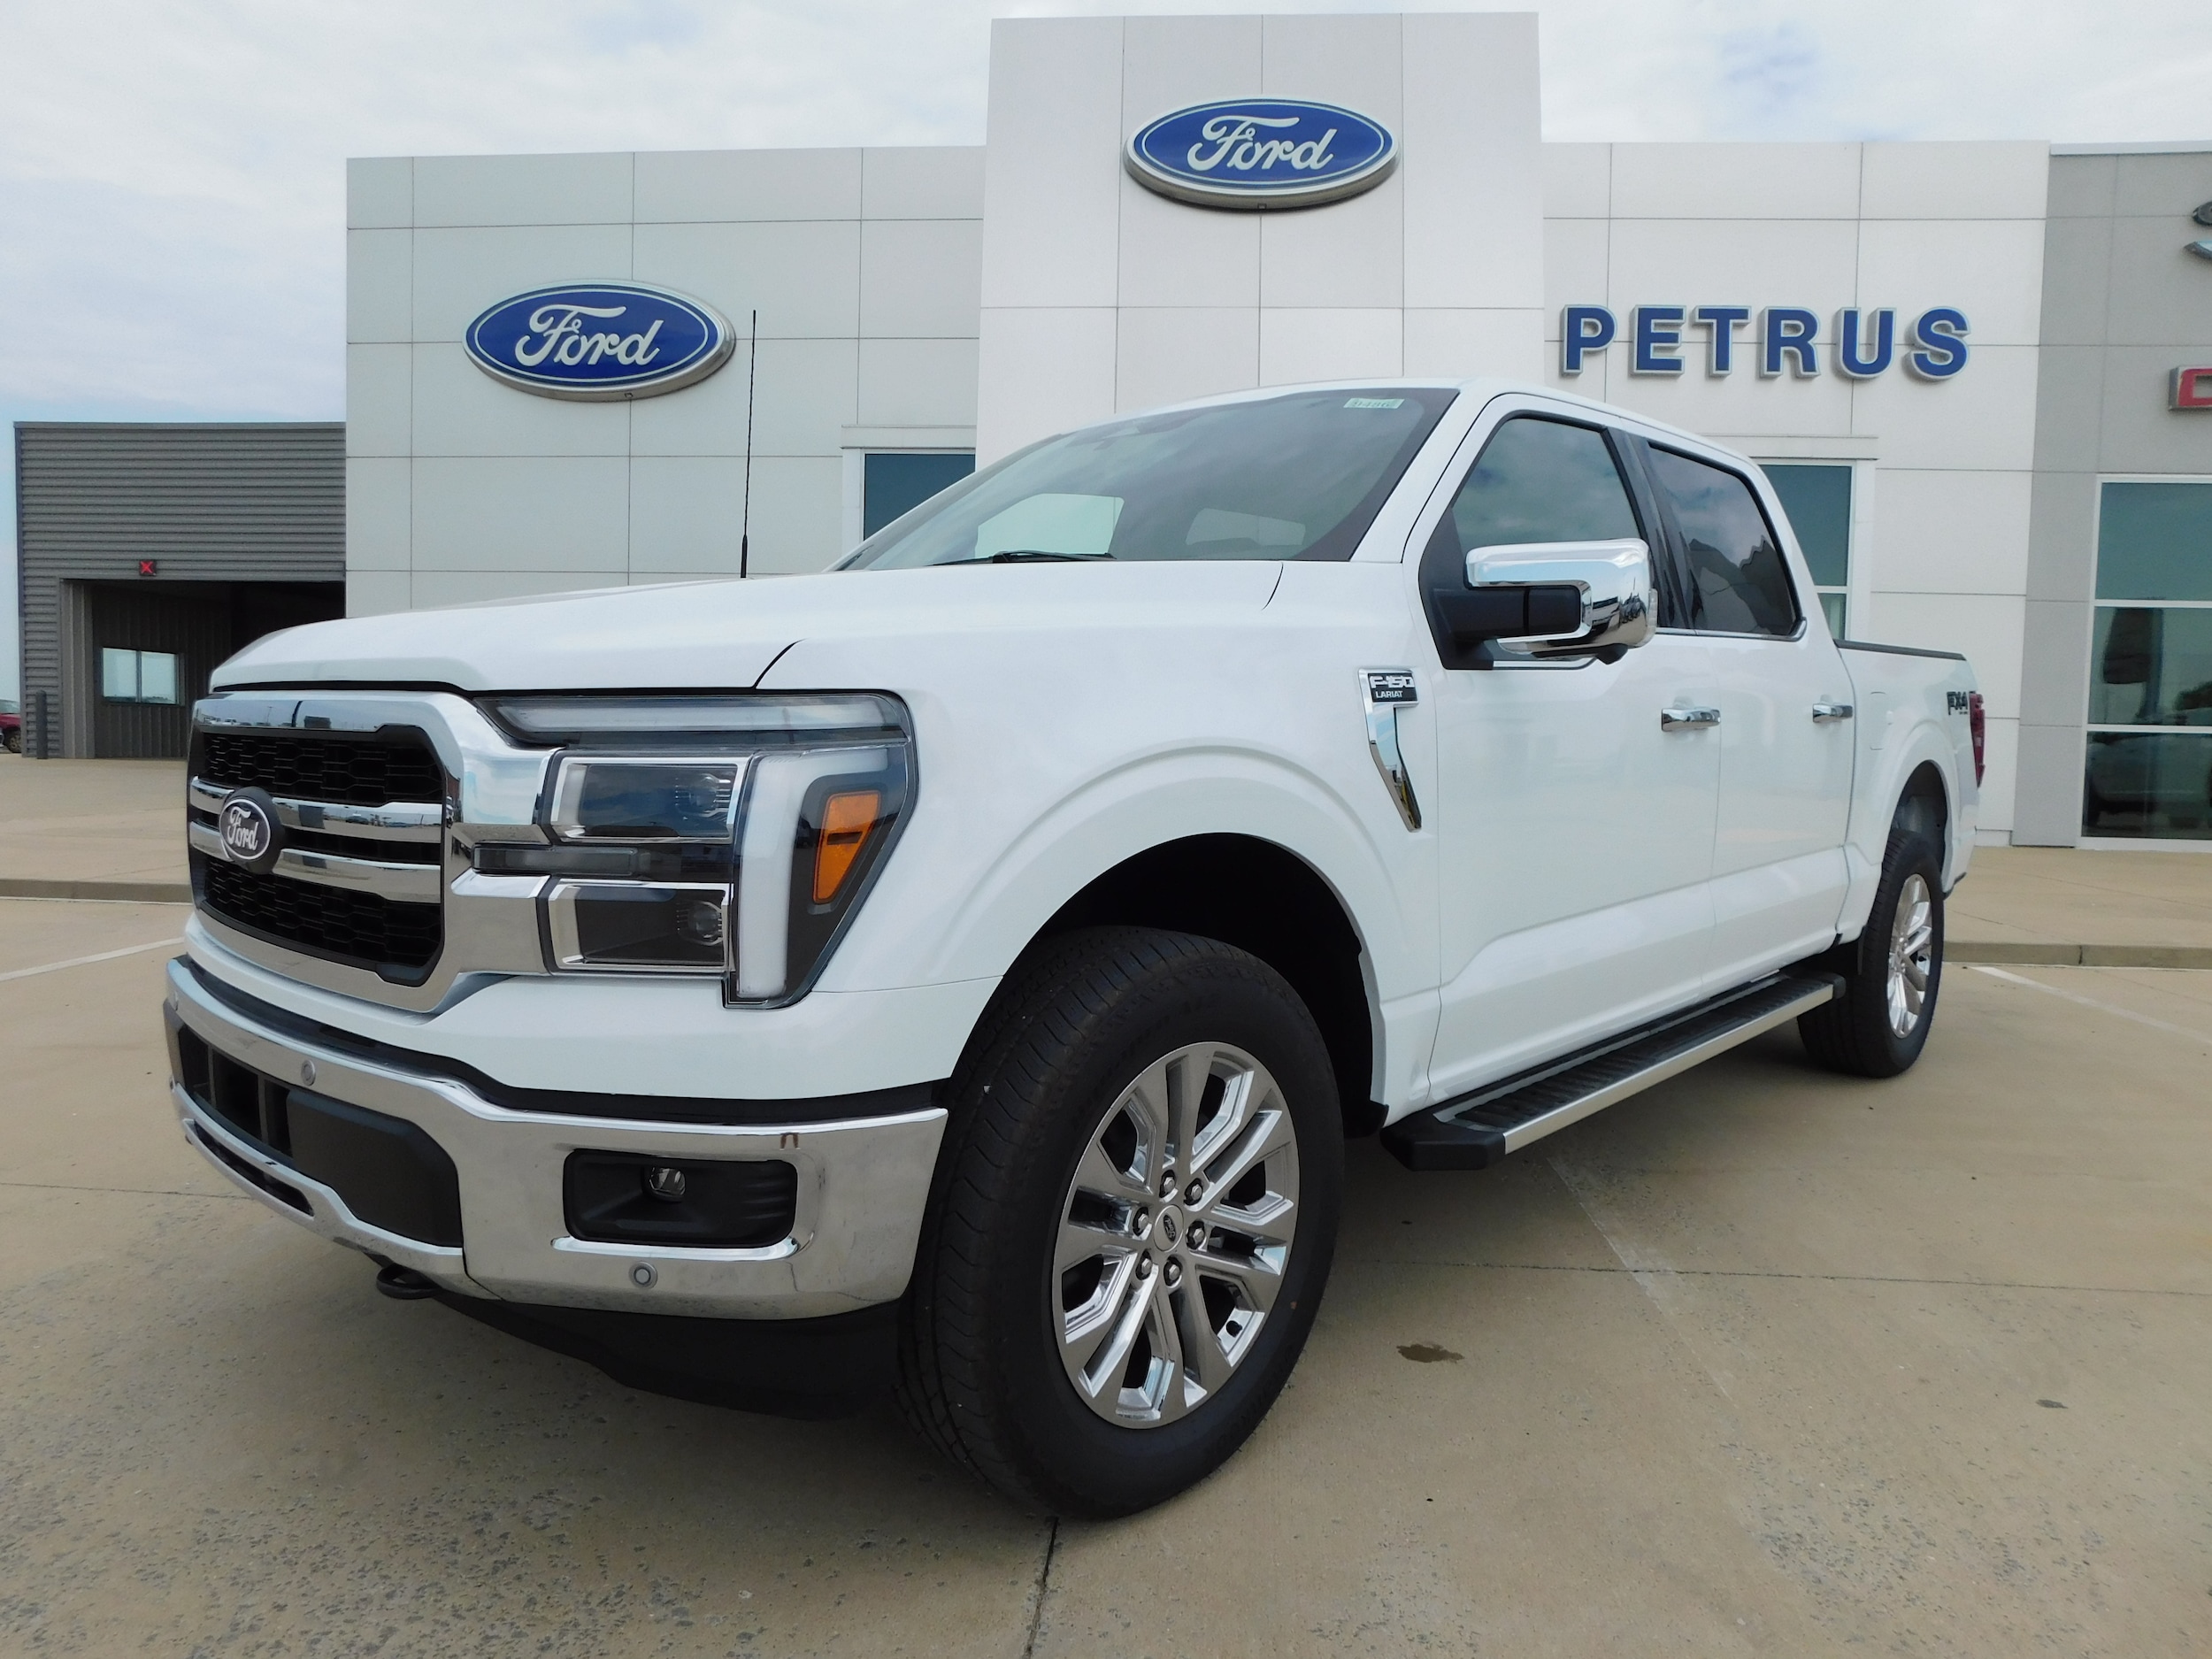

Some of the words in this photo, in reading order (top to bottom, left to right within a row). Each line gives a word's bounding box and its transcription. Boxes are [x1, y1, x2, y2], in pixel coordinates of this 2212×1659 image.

[1187, 115, 1338, 171] Ford
[514, 303, 664, 366] Ford
[1563, 304, 1970, 380] PETRUS
[1369, 675, 1415, 688] F-150
[227, 806, 259, 850] Ford
